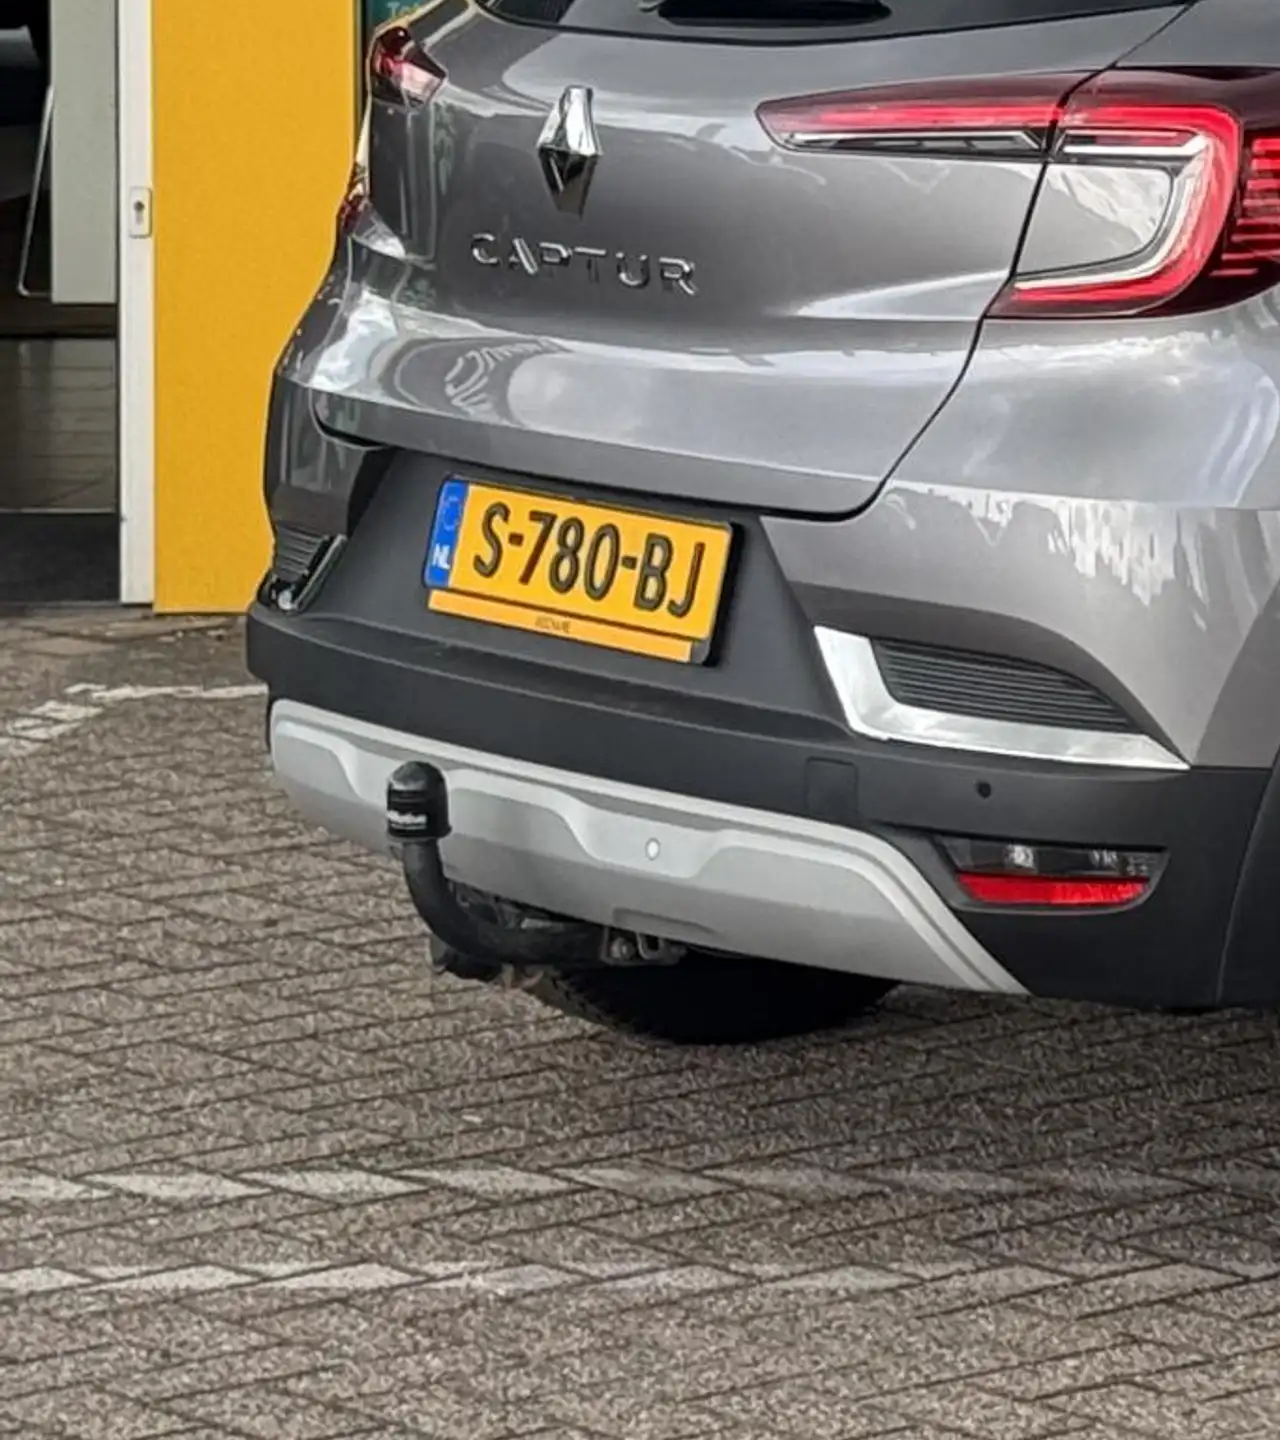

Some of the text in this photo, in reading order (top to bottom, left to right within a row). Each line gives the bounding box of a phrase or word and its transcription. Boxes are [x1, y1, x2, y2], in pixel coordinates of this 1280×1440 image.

[470, 232, 697, 296] CAPTUR
[431, 543, 451, 570] NL
[473, 501, 706, 618] S-780-BJ
